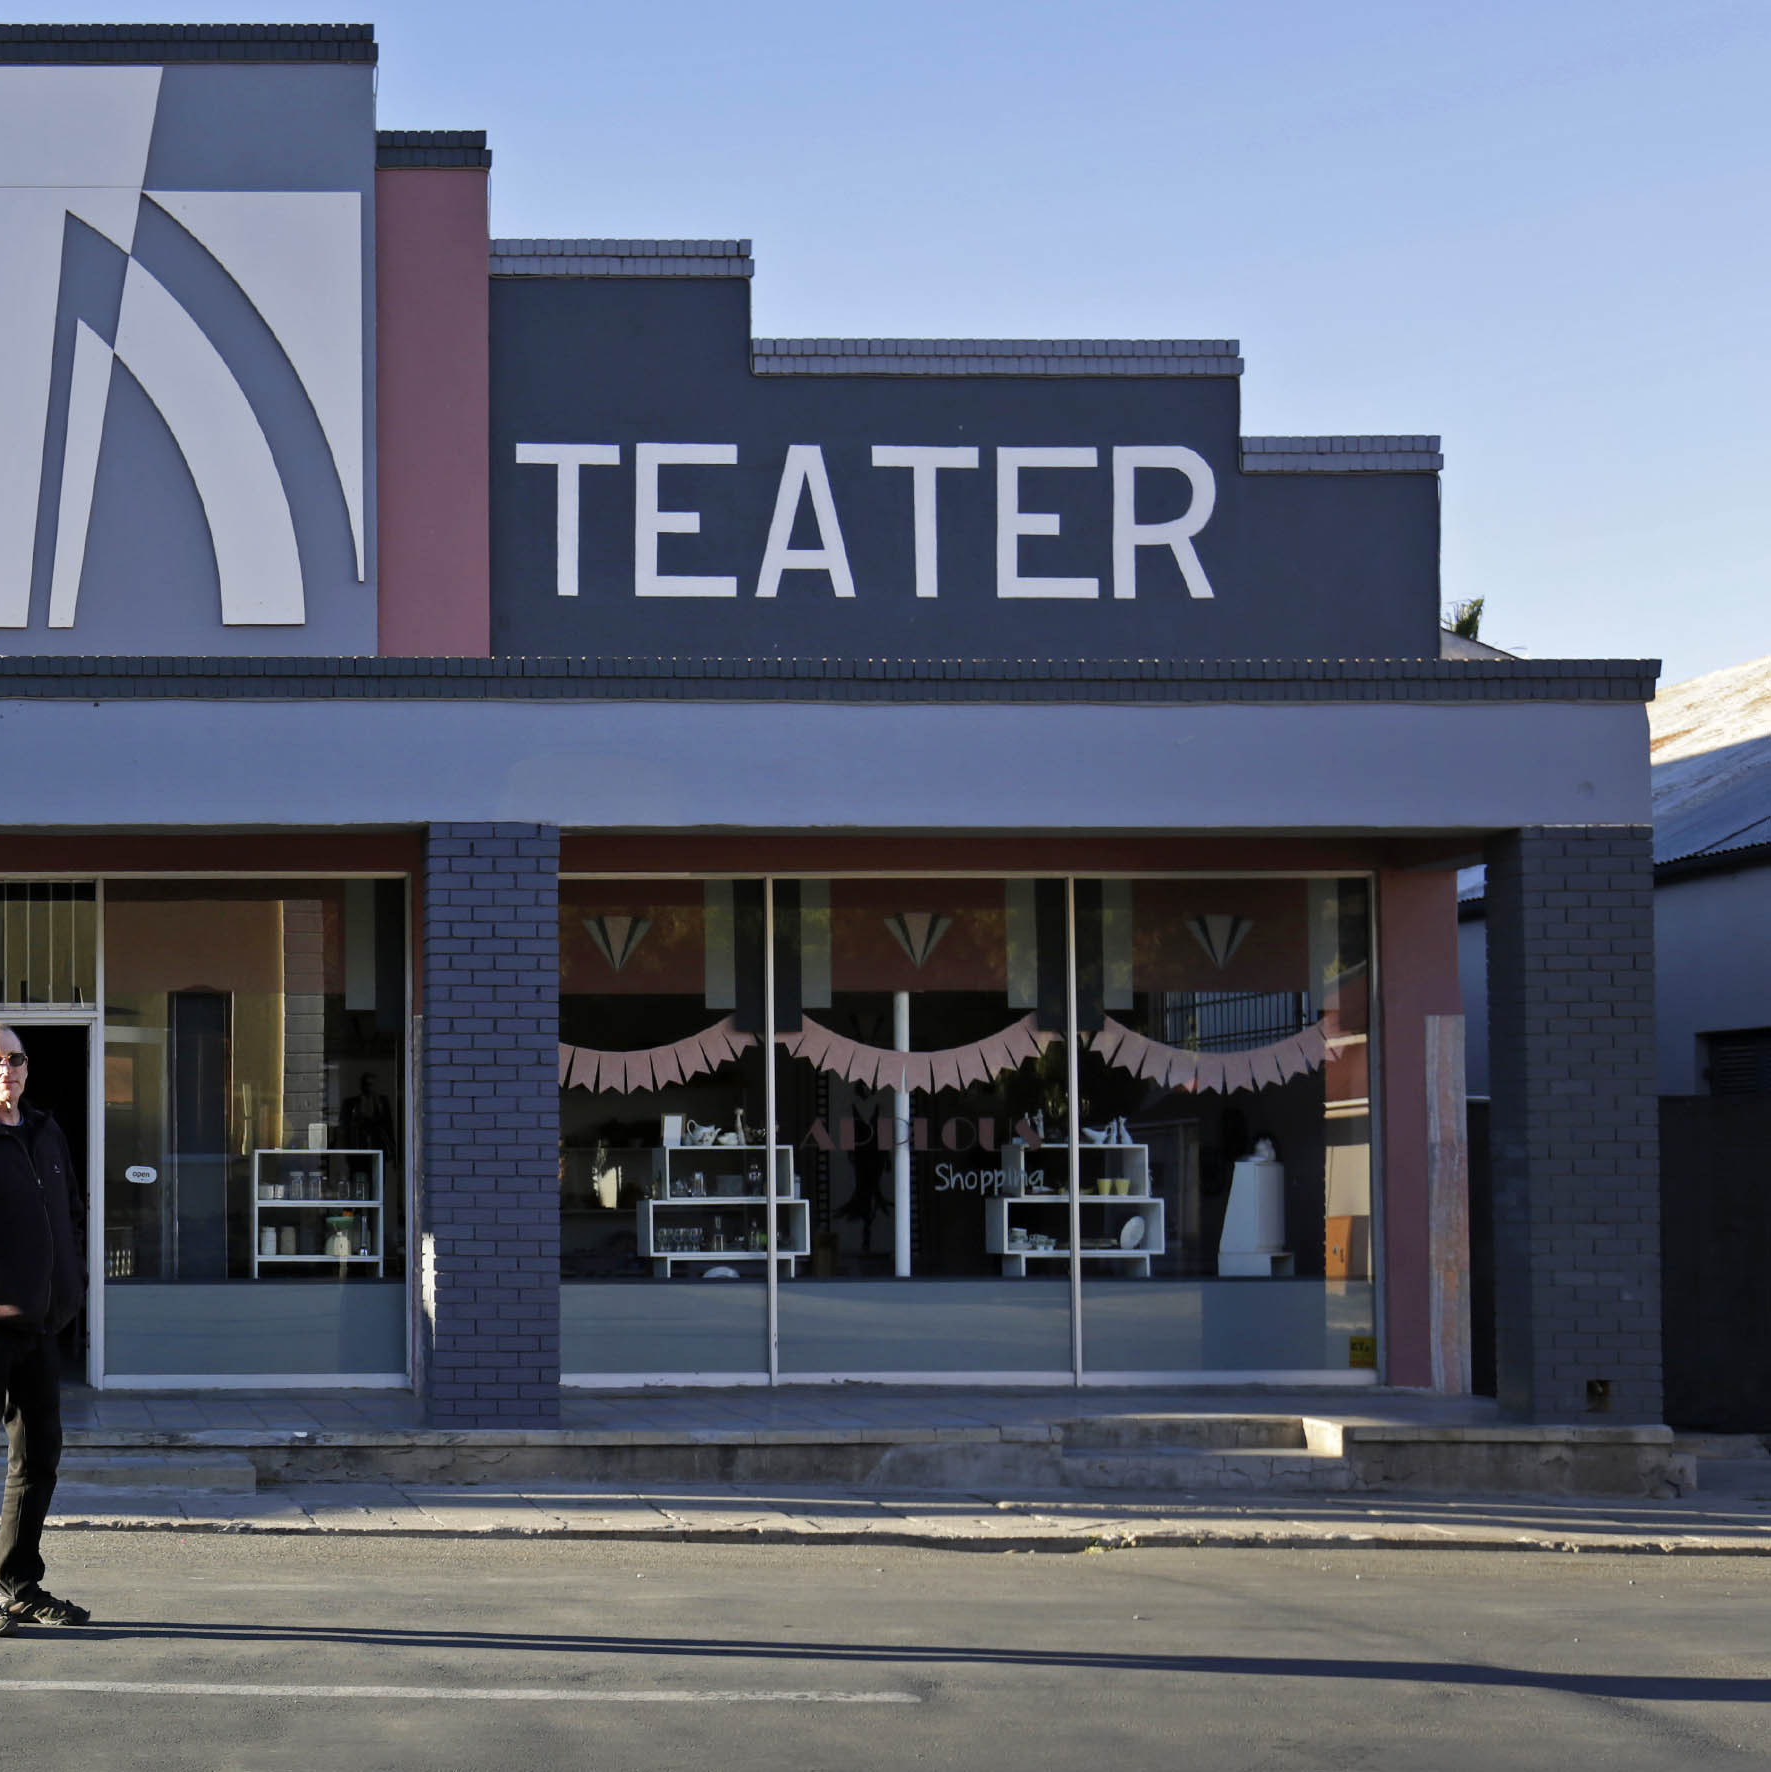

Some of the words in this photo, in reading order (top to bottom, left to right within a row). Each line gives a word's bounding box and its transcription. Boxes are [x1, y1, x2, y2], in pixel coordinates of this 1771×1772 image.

[516, 443, 1217, 599] TEATER
[799, 1116, 1042, 1152] APPLOUS
[934, 1162, 1045, 1196] Shopping
